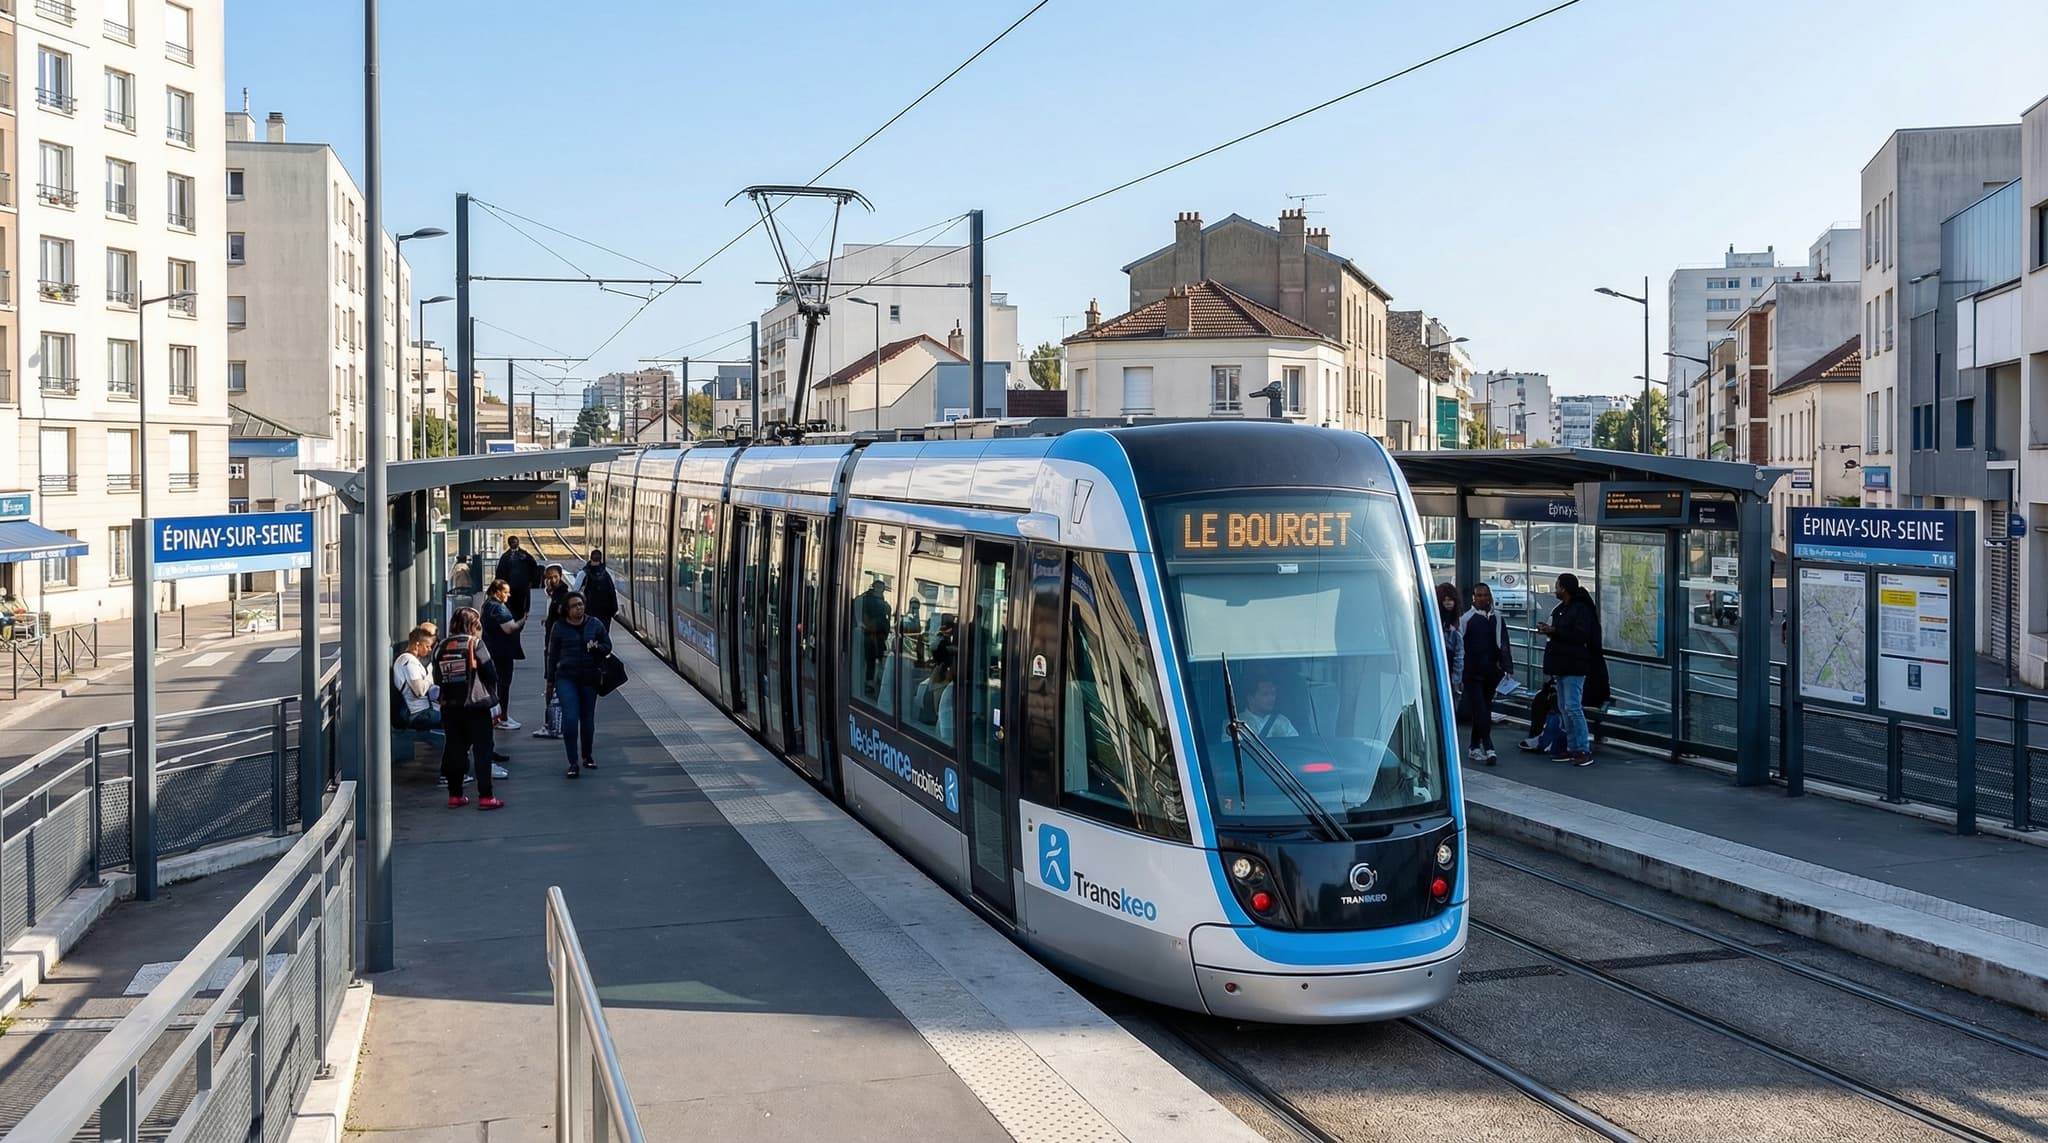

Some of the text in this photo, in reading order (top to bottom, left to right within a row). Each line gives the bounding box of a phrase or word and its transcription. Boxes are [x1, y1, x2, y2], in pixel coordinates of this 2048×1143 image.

[162, 523, 303, 551] ÉPINAY-SUR-SEINE
[1184, 512, 1352, 548] LE BOURGET
[1803, 513, 1945, 541] ÉPINAY-SUR-SEINE
[1073, 870, 1157, 921] Transkeo
